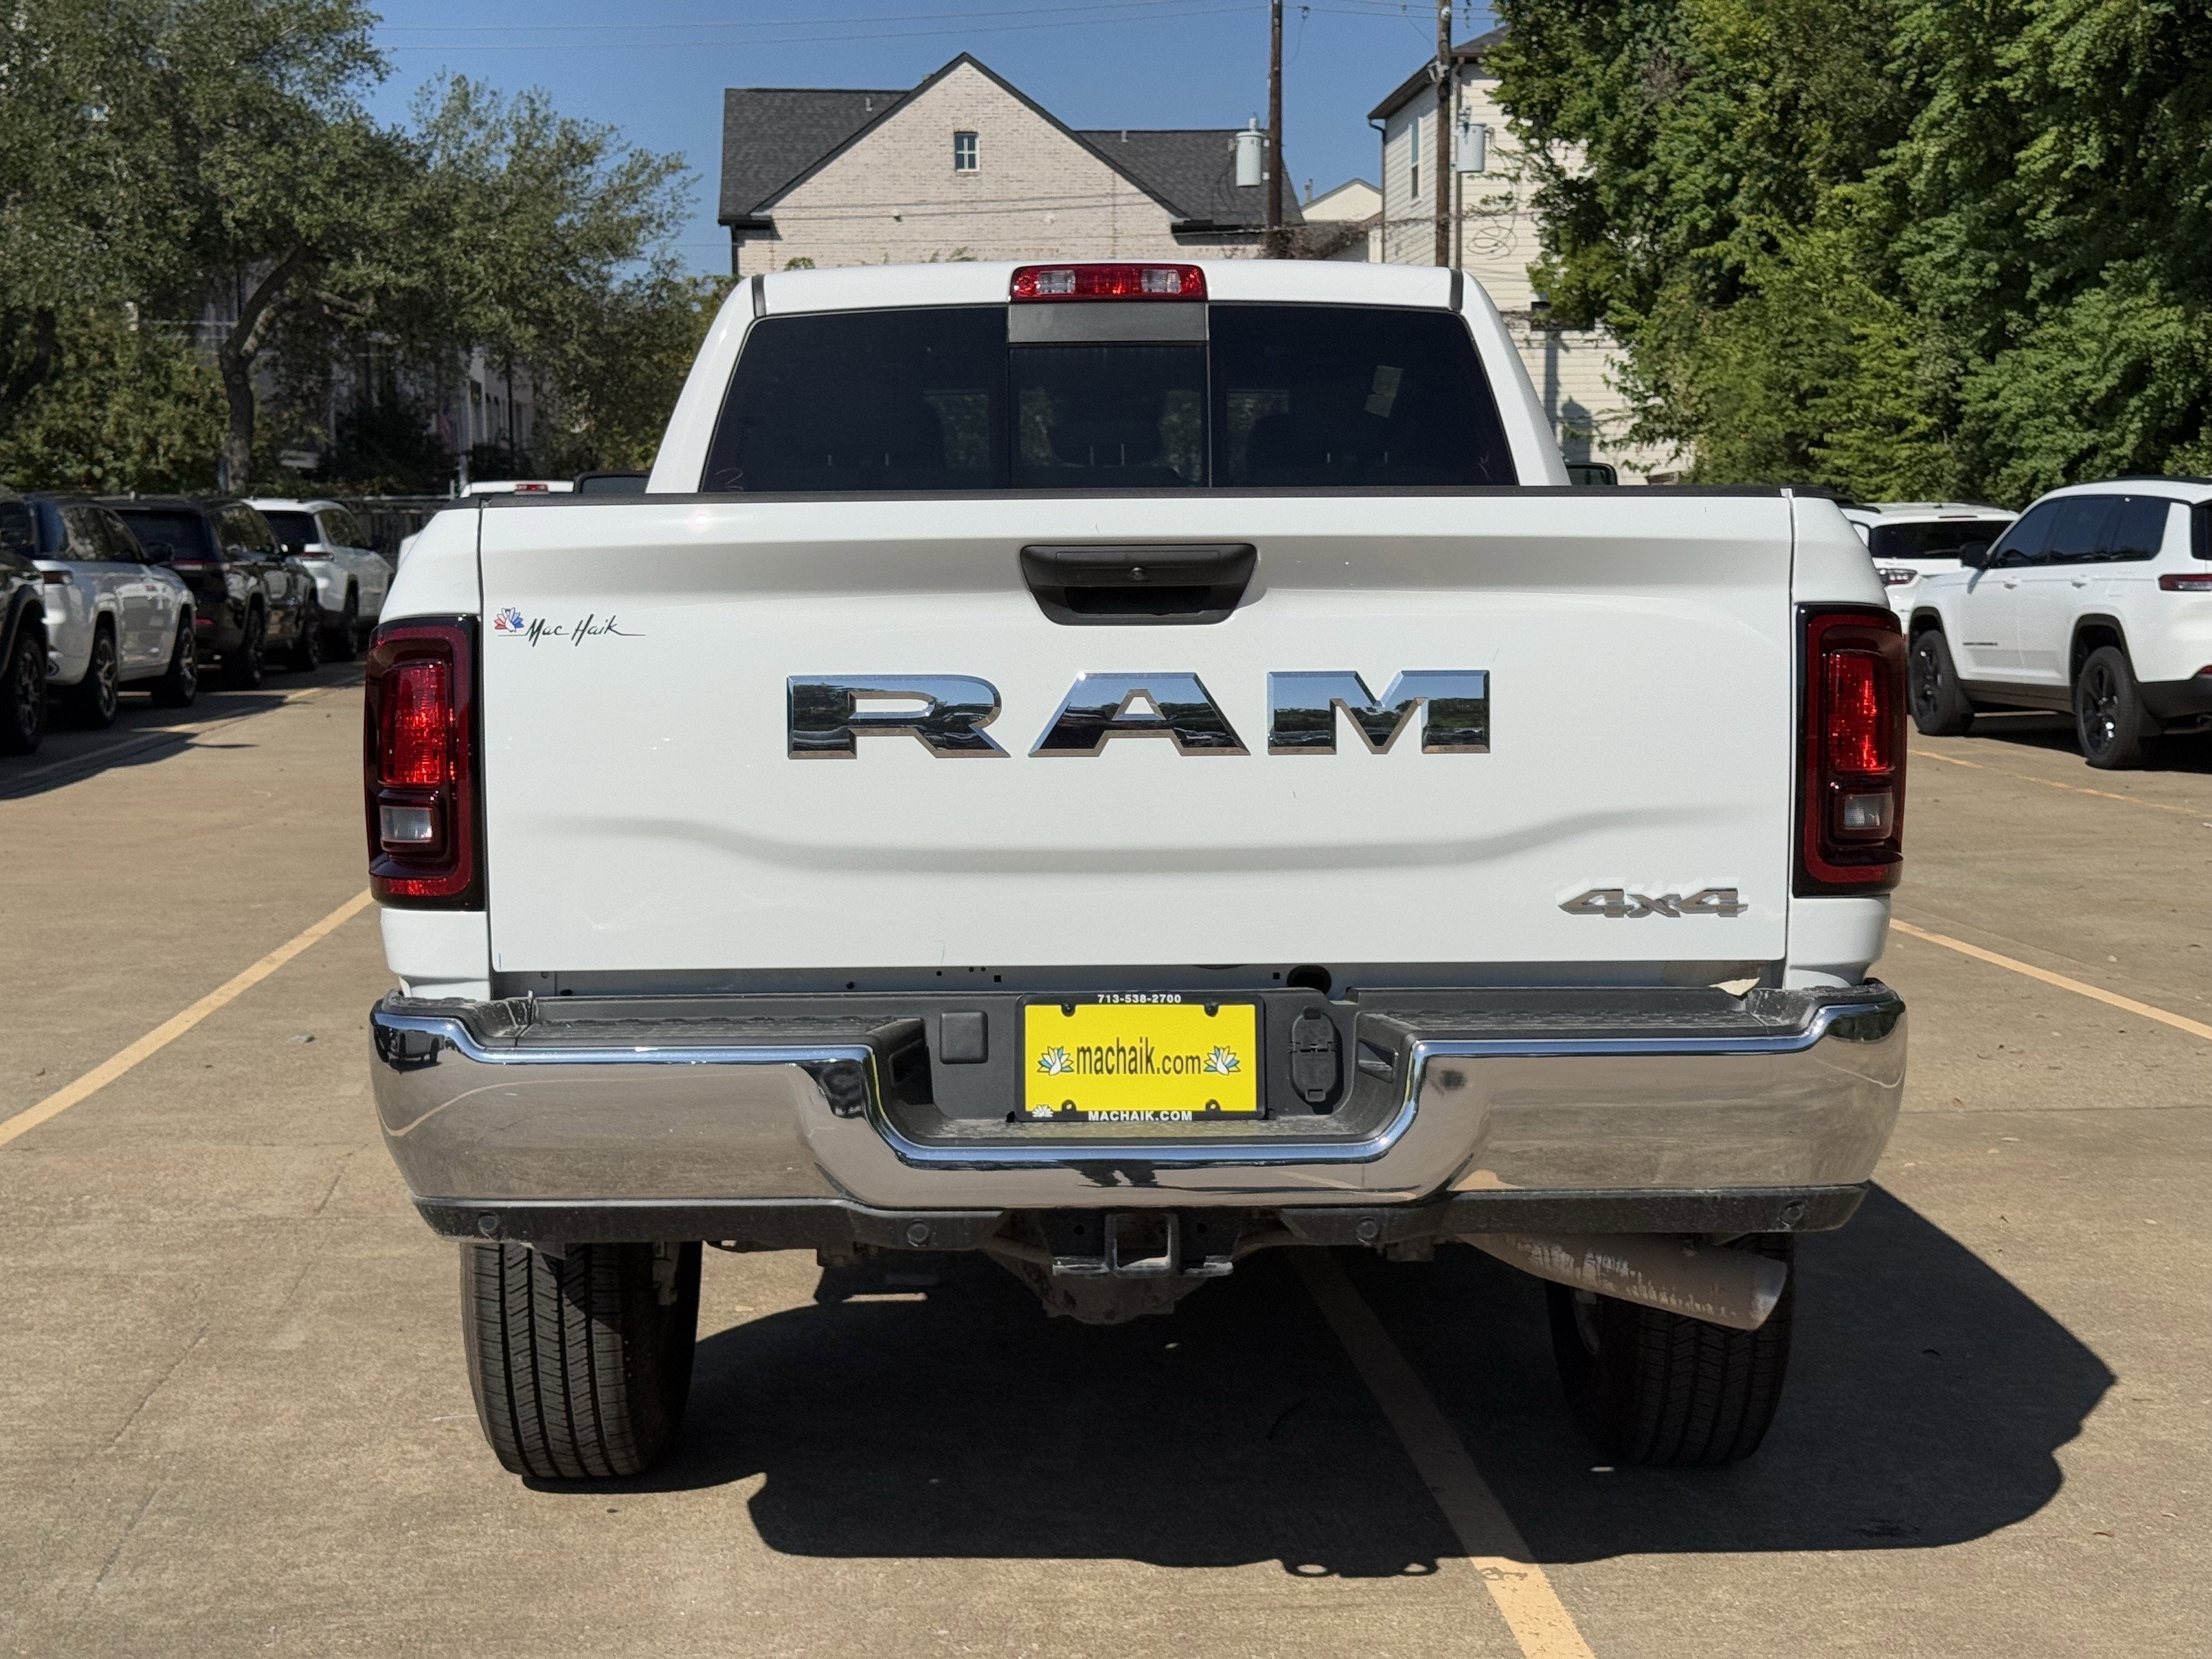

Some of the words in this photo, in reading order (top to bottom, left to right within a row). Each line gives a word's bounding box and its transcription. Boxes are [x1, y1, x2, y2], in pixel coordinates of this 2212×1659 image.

[498, 618, 569, 647] Mac
[571, 613, 646, 647] Haik
[787, 670, 1491, 759] RAM
[1558, 887, 1748, 918] 4x4
[1097, 994, 1182, 1003] 713-538-2700
[1076, 1036, 1201, 1075] machaik.com
[1088, 1110, 1193, 1121] MACHAIK.COM
